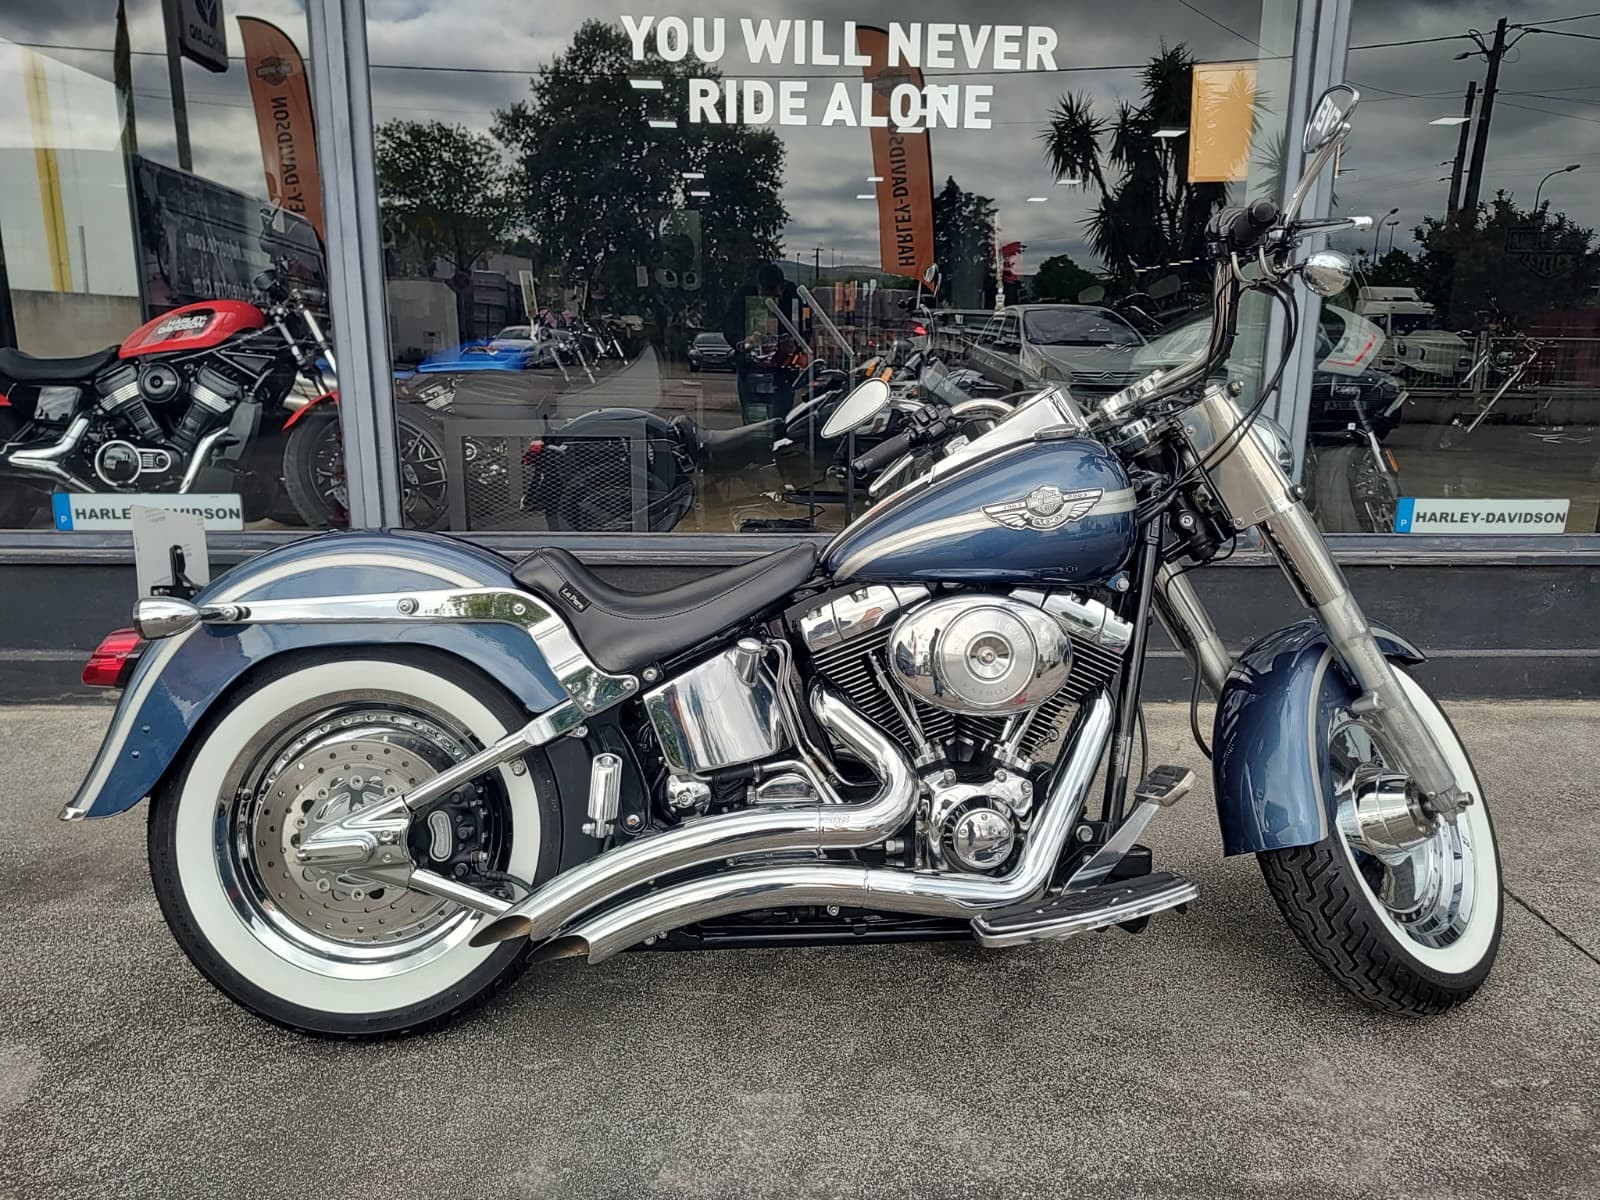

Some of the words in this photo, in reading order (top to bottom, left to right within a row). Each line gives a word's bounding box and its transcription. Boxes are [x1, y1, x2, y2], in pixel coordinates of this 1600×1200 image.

[620, 15, 726, 62] YOU
[740, 18, 872, 67] WILL
[887, 22, 1059, 71] NEVER
[688, 79, 808, 125] RIDE
[821, 82, 994, 129] ALONE
[60, 515, 68, 525] P
[1400, 519, 1408, 528] P
[1415, 512, 1567, 524] HARLEY-DAVIDSON
